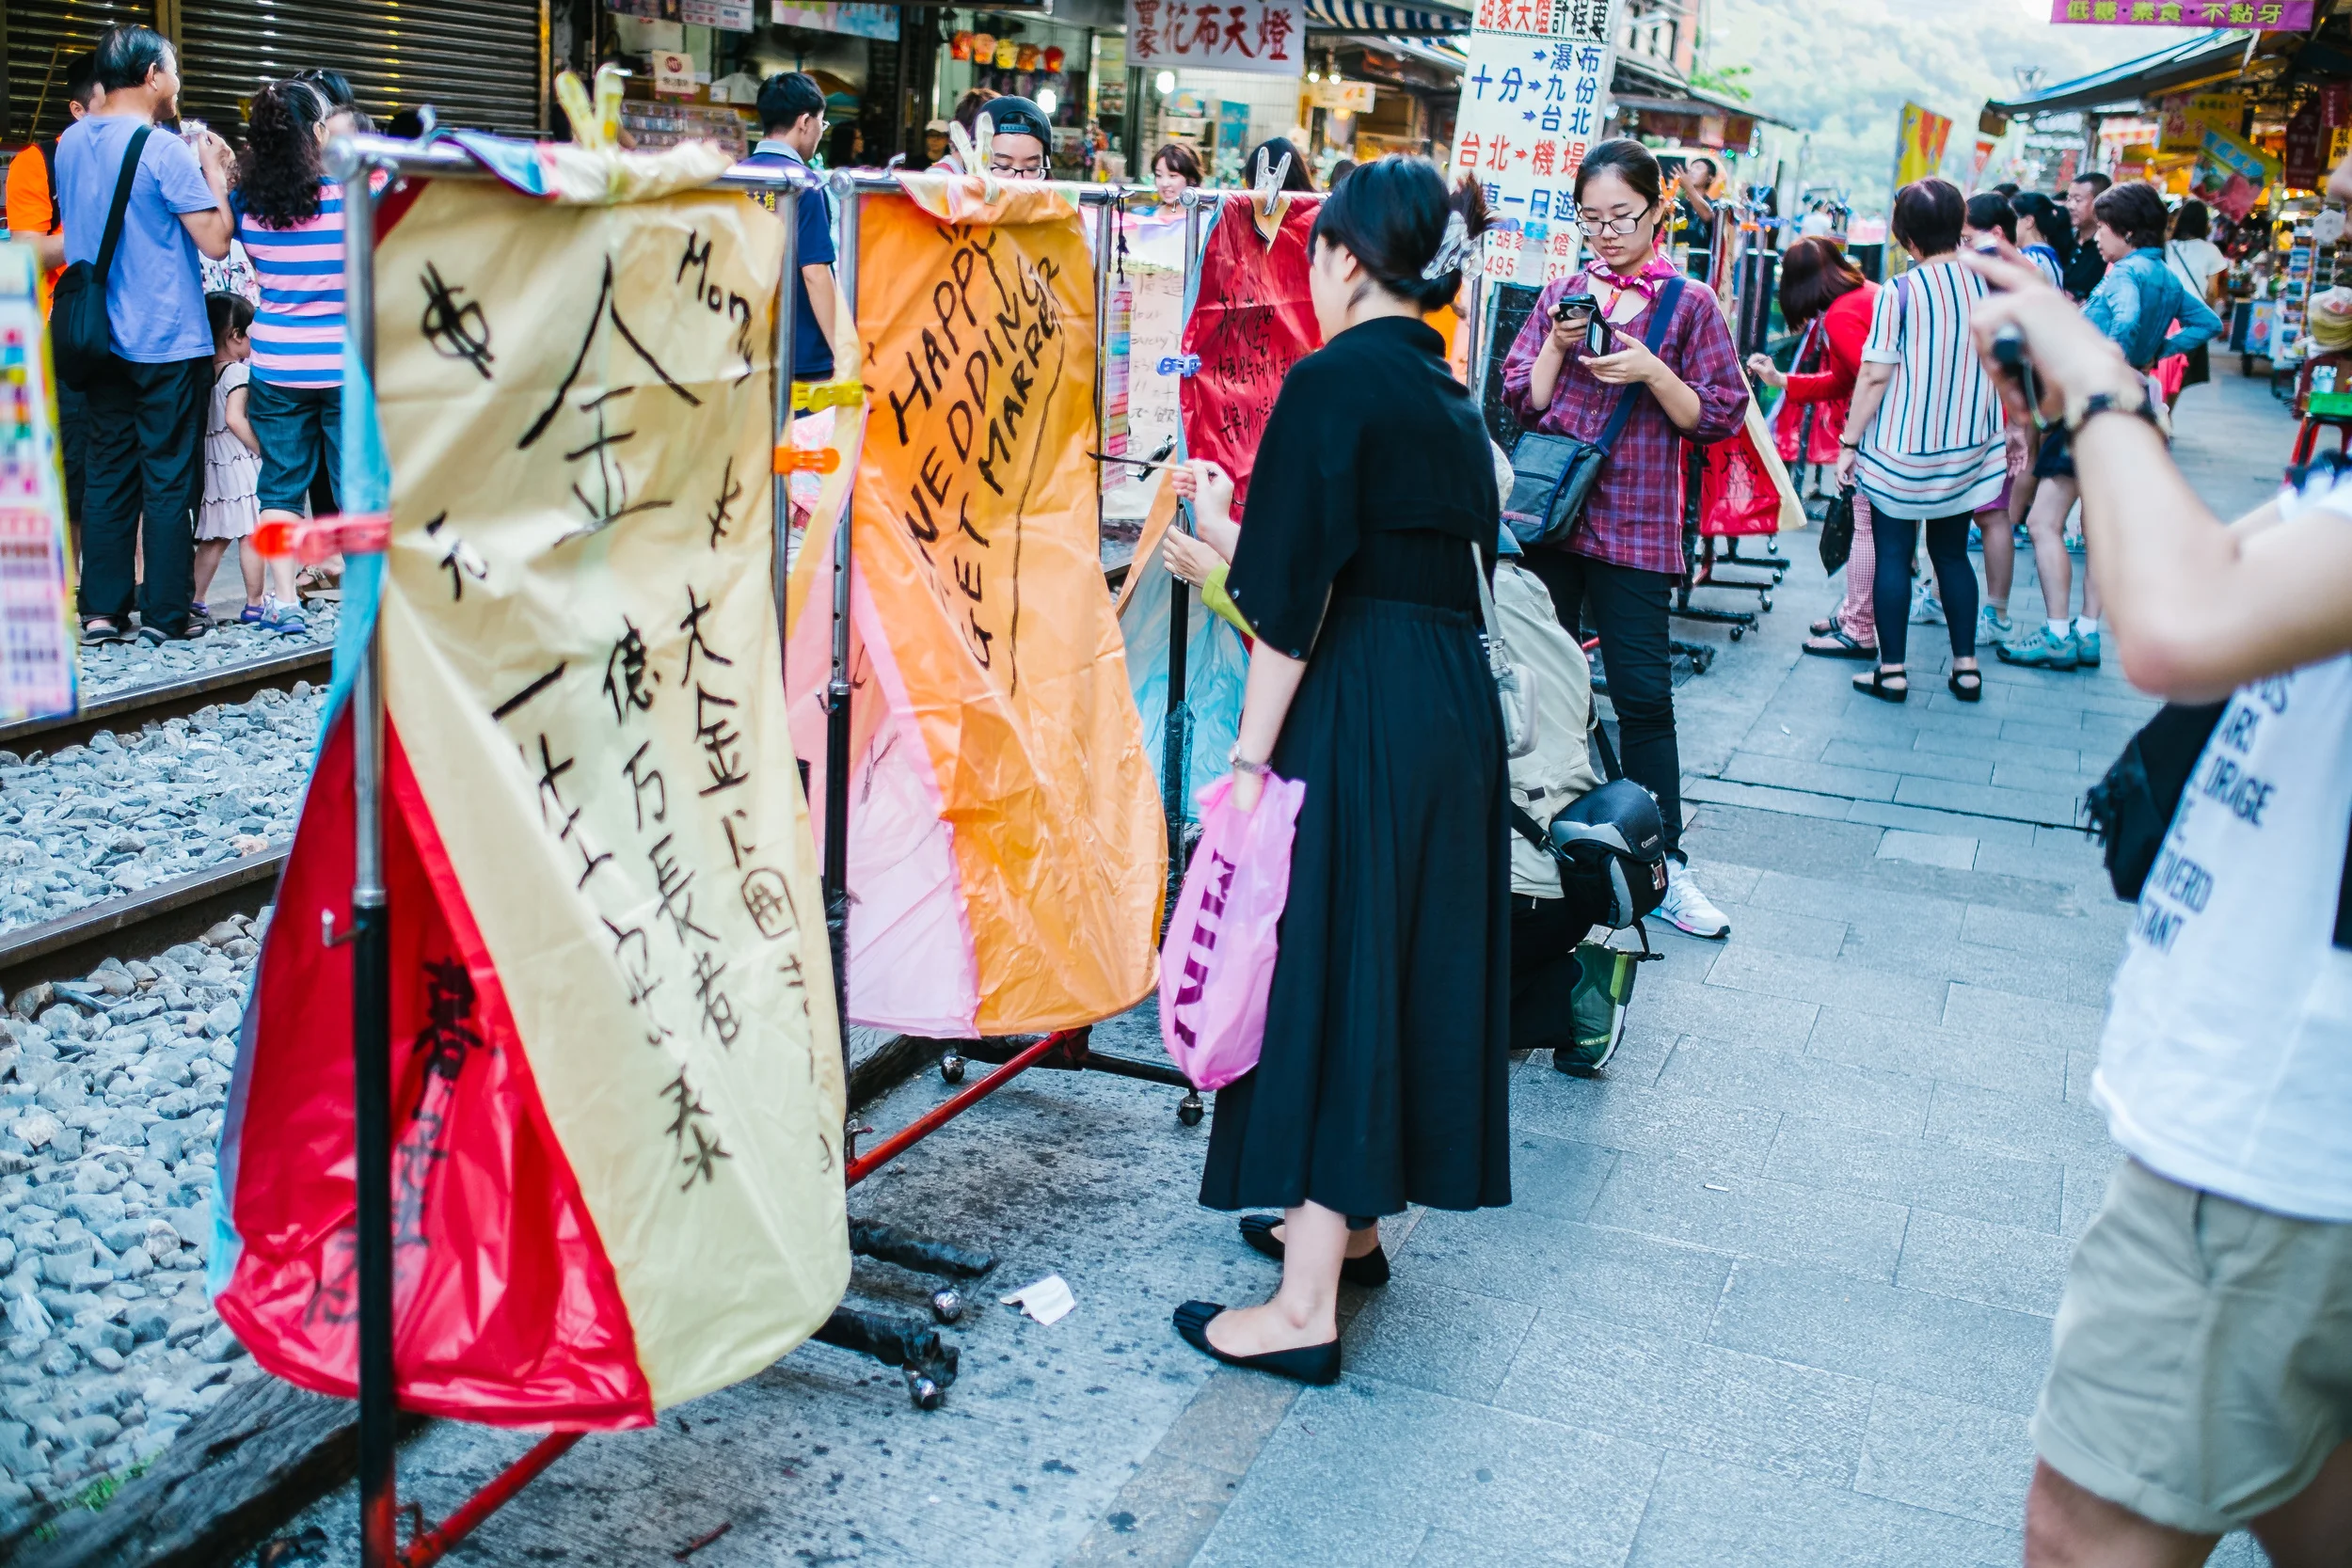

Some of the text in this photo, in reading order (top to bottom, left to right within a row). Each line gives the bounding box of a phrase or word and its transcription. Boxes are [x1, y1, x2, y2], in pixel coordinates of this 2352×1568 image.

[1471, 63, 1597, 105] 十分 九份
[1541, 103, 1592, 135] 台北
[1459, 131, 1511, 172] 台北
[888, 230, 996, 447] HAPPY
[959, 491, 992, 671] GET
